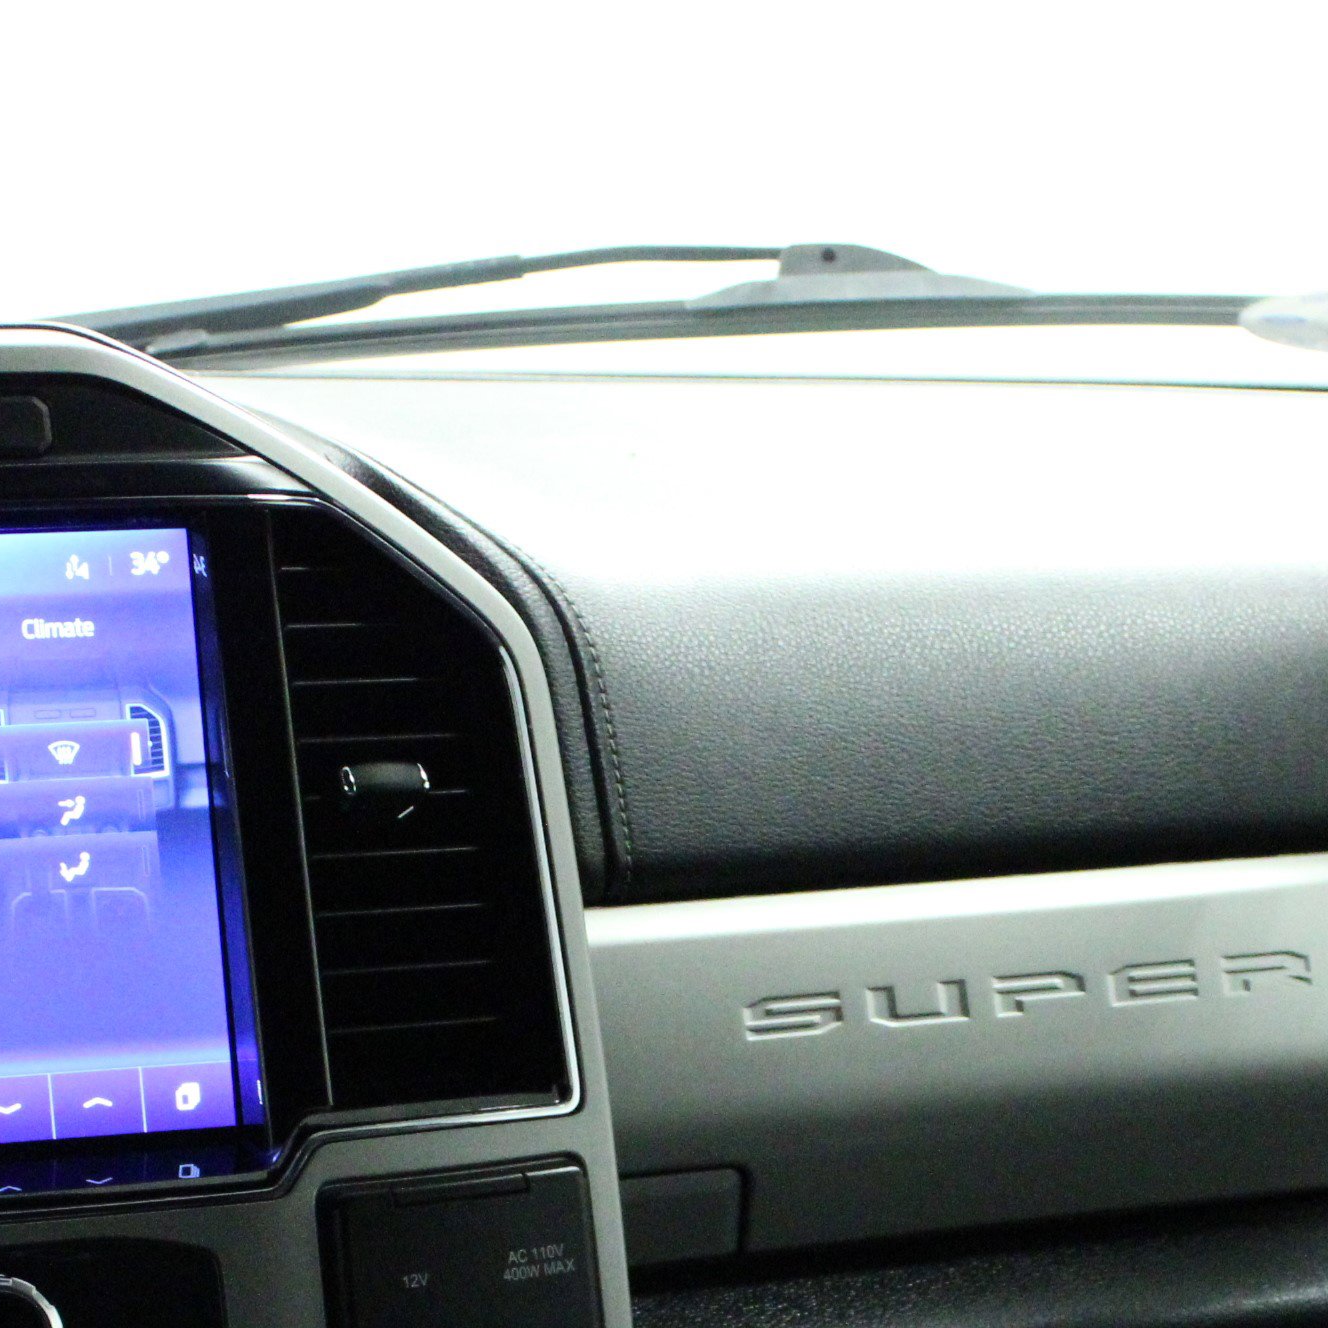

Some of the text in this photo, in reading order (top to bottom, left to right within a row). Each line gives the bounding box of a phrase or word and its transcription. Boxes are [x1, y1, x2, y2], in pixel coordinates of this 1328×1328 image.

[21, 617, 95, 639] Climate
[740, 948, 1313, 1042] SUPER
[508, 1243, 565, 1265] AC 110V
[402, 1273, 429, 1289] 12V
[502, 1258, 575, 1282] 400W MAX
